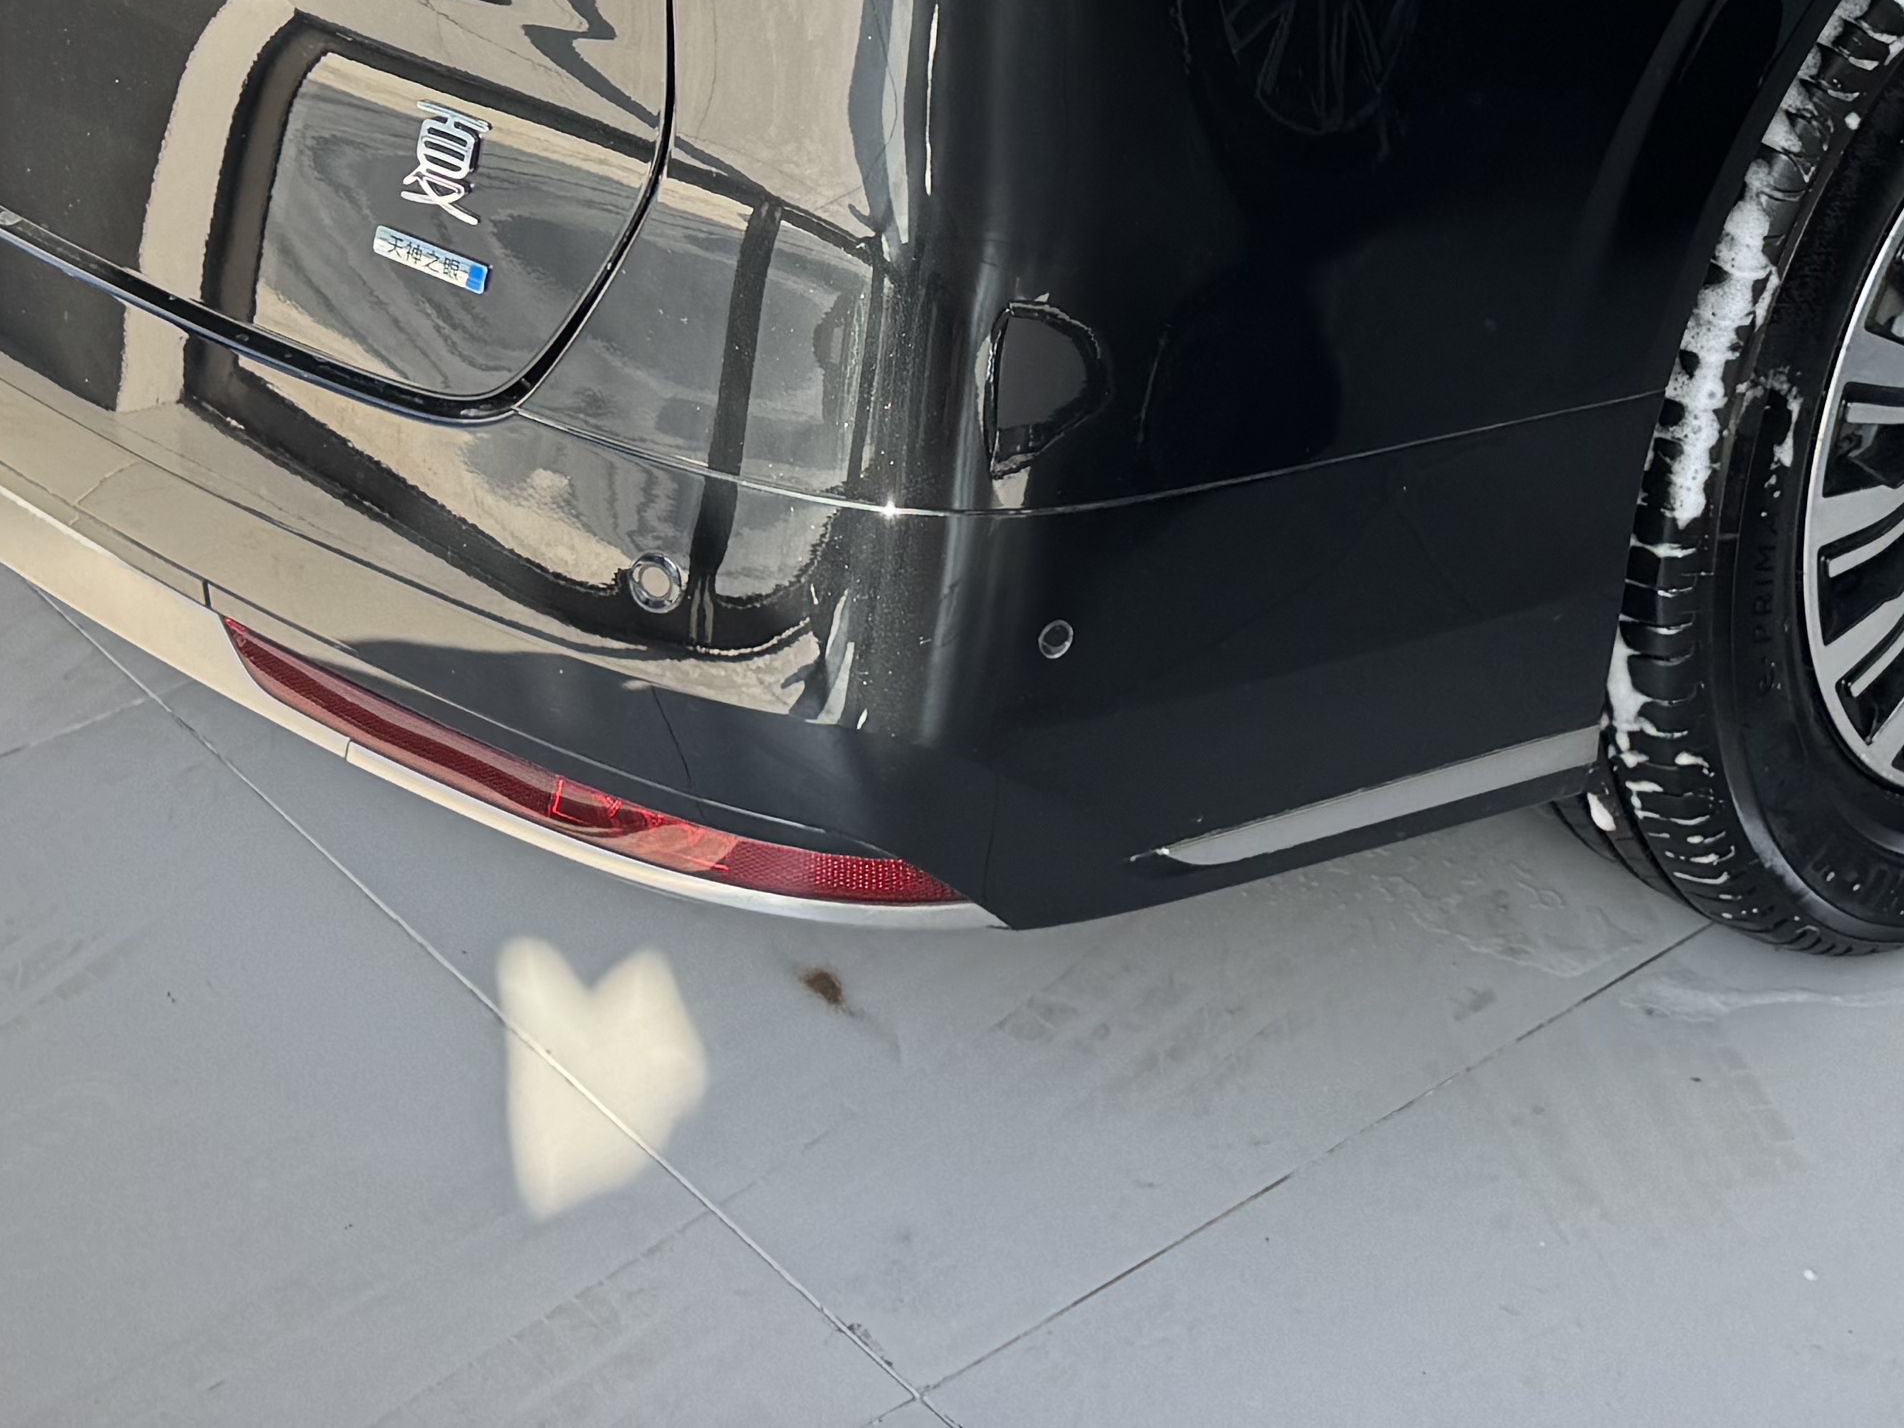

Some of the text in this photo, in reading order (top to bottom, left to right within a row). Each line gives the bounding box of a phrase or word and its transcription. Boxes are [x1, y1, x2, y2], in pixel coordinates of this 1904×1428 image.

[401, 100, 493, 226] 夏
[387, 235, 461, 281] 天神之眼
